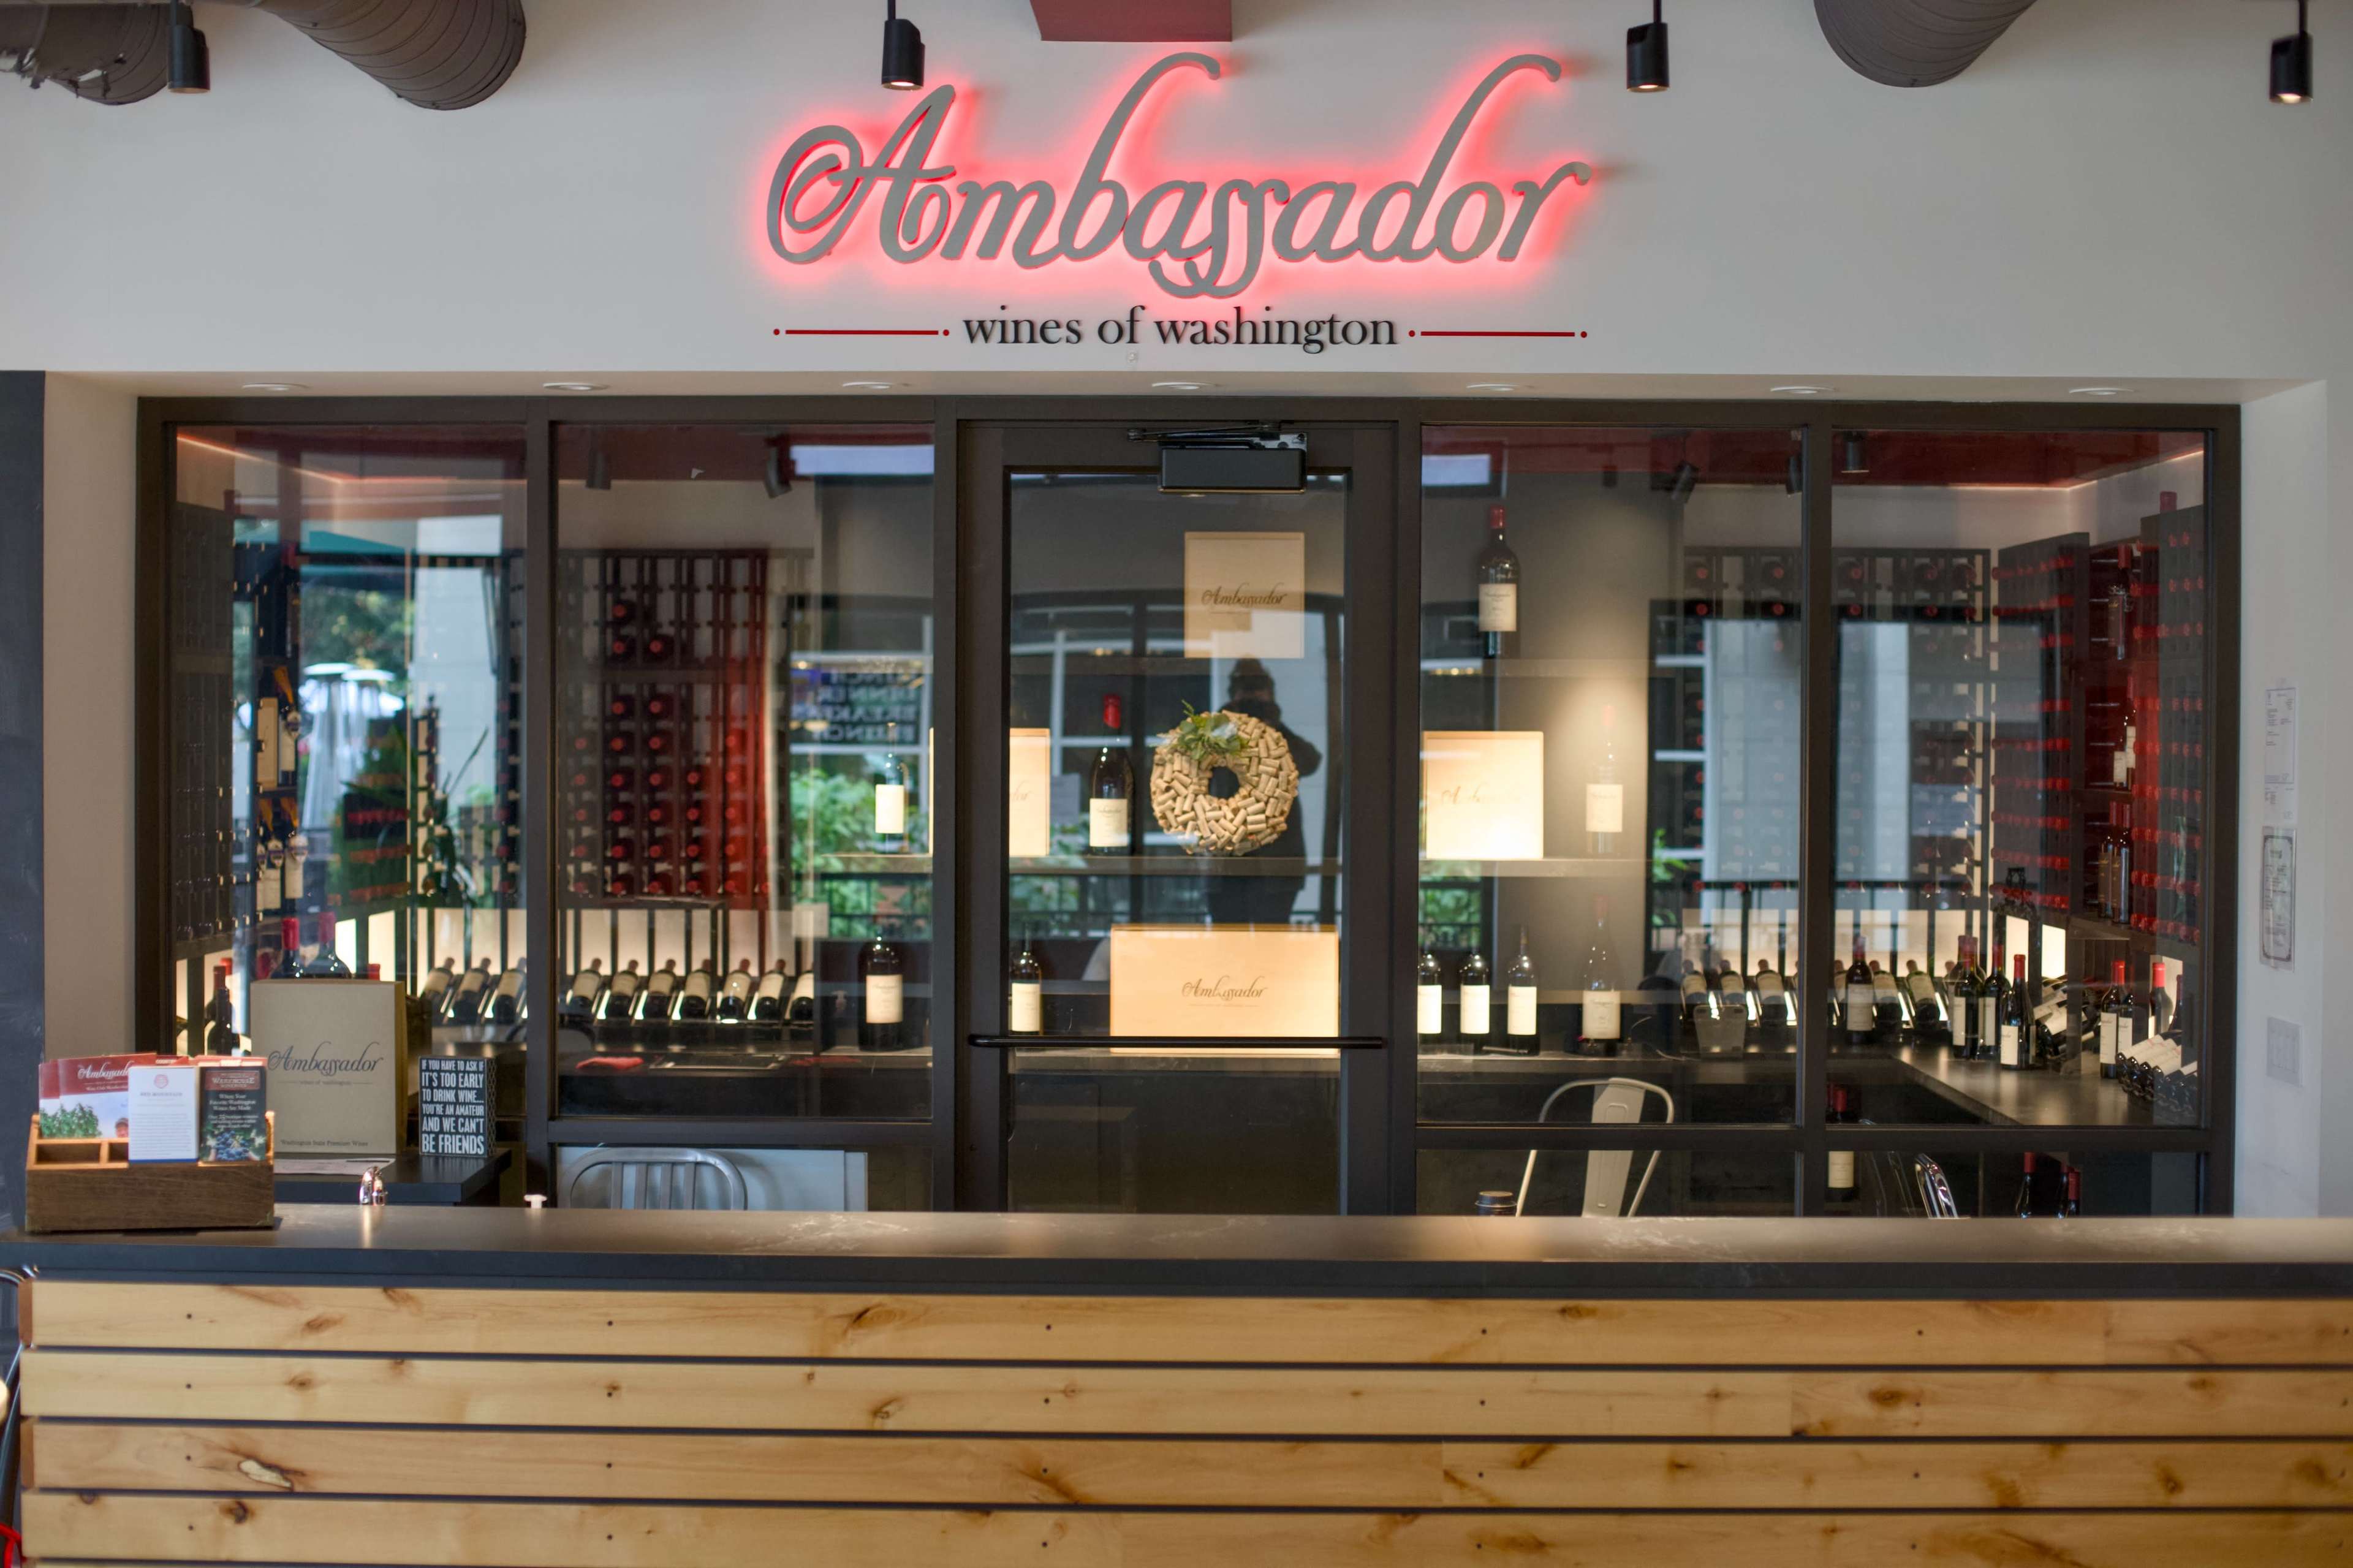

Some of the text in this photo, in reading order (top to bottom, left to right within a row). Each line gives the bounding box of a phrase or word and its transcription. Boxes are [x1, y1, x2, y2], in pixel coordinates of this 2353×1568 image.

[768, 52, 1591, 298] Ambassador
[963, 305, 1398, 354] wines of washington
[1201, 582, 1287, 608] Ambassador
[267, 1041, 384, 1076] Ambassador
[422, 1059, 483, 1071] IF YOU HAVE TO ASK IF
[77, 1061, 134, 1079] Ambassad
[422, 1072, 483, 1088] IT'S TOO EARLY
[422, 1089, 483, 1103] TO DRINK WINE...
[422, 1104, 483, 1116] YOU'RE AN AMATEUR
[422, 1116, 483, 1133] AND WE CAN'T
[422, 1134, 484, 1154] BE FRIENDS
